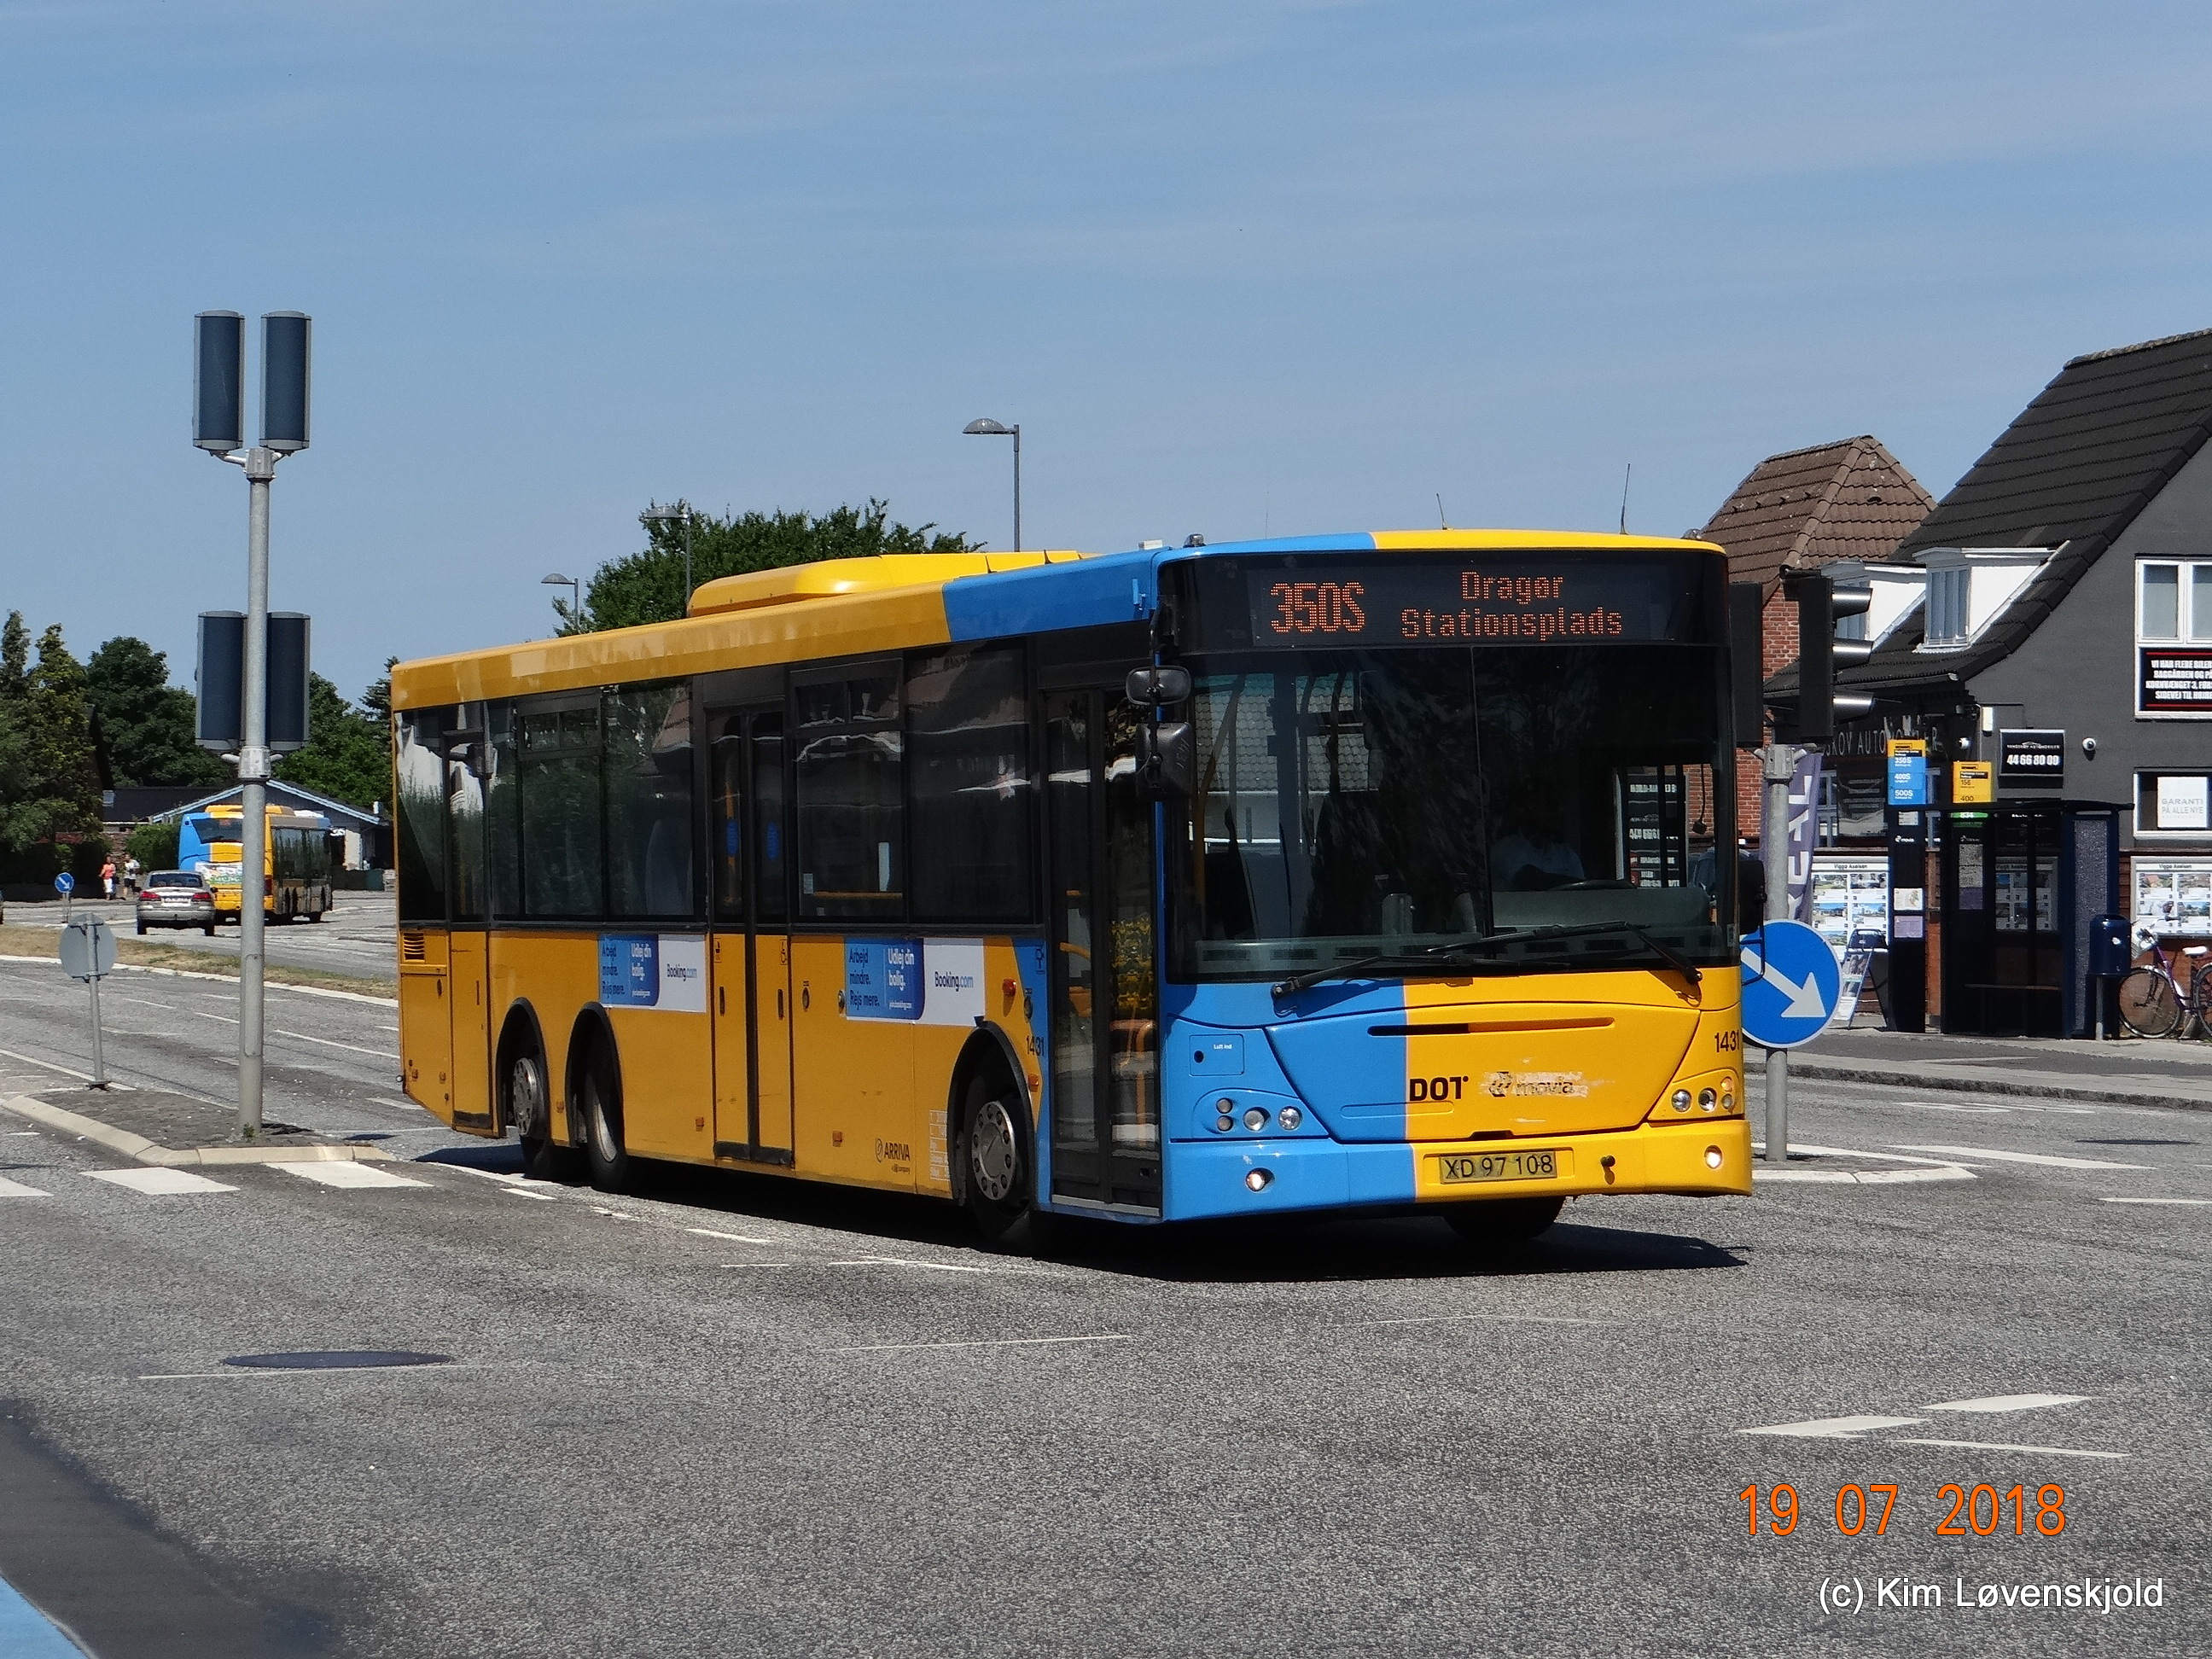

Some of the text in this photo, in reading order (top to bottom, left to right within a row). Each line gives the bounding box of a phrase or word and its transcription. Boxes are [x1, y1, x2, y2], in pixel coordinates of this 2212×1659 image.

[1462, 571, 1564, 605] Dragør
[1269, 581, 1366, 633] 350S
[1401, 607, 1622, 642] Stationsplads
[2006, 754, 2059, 765] 44 66 80 00
[848, 947, 869, 969] Arbejd
[888, 947, 915, 969] Udlej din
[666, 963, 698, 982] Booking.com
[849, 969, 871, 986] mindre.
[888, 969, 906, 992] bolig.
[934, 970, 974, 992] Booking.com
[849, 990, 863, 1010] Rejs
[863, 994, 880, 1007] mere.
[1026, 1035, 1045, 1057] 1431
[1714, 1029, 1740, 1053] 1431
[1409, 1076, 1469, 1102] DOT
[884, 1142, 911, 1161] ARRIVA
[1443, 1154, 1553, 1179] XD 97 108
